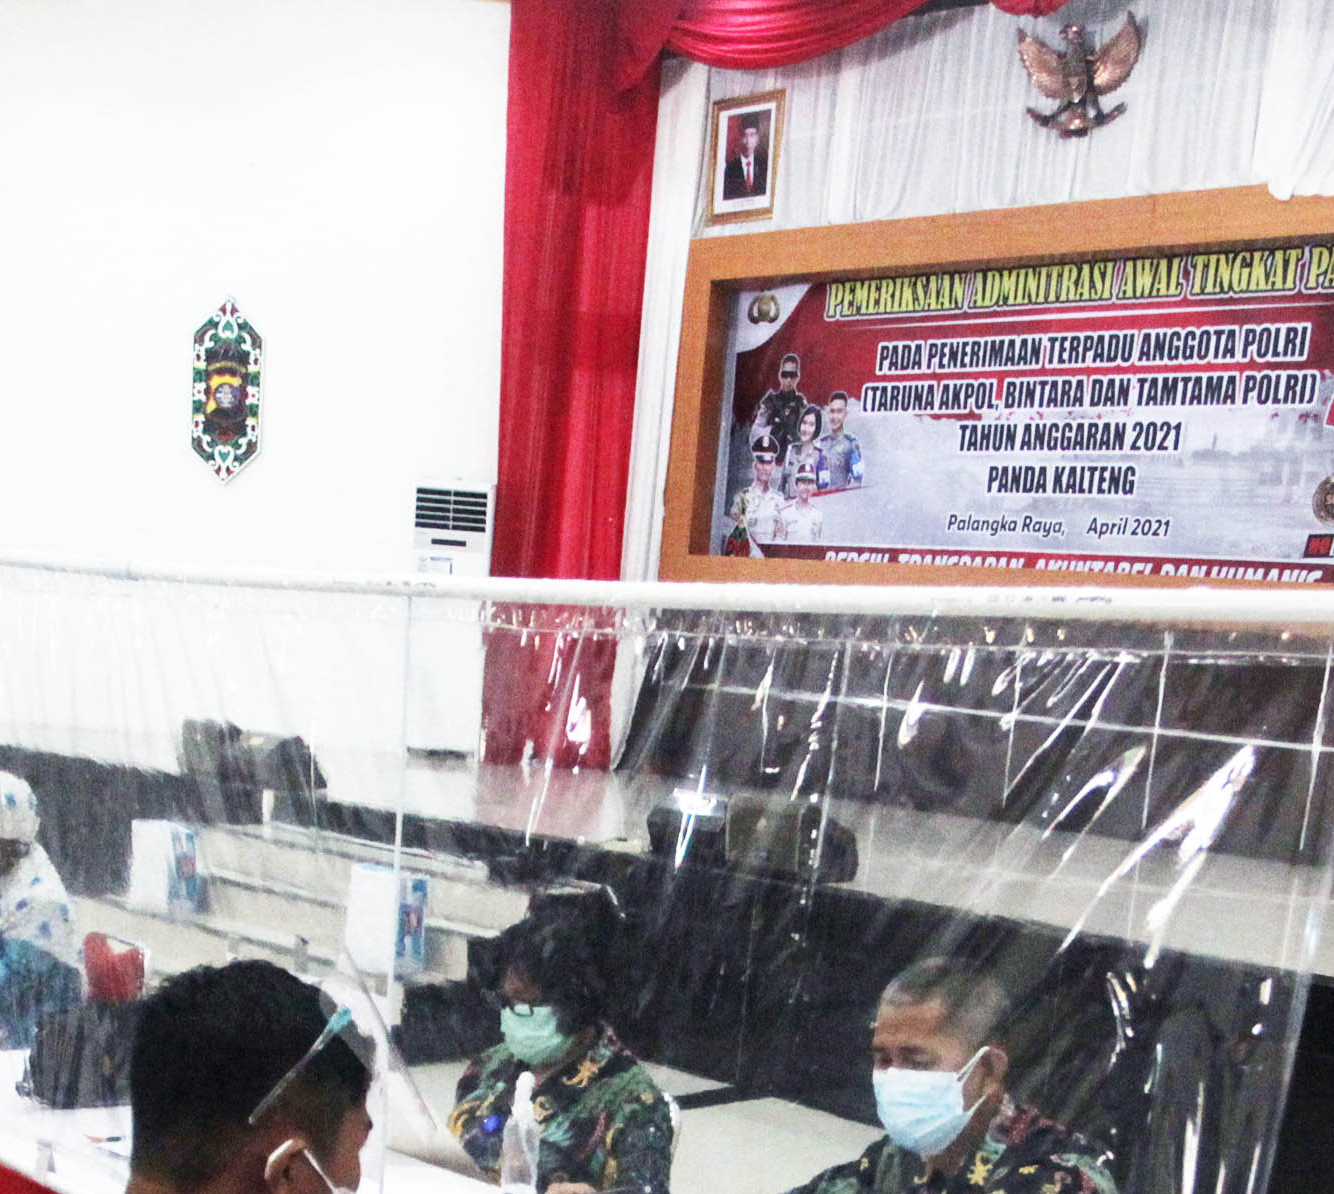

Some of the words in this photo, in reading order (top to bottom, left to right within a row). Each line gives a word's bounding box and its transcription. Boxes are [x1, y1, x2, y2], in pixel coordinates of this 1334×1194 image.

[827, 271, 966, 318] PEMERIKSAAN
[967, 261, 1116, 309] ADMINITRASI
[1117, 257, 1183, 300] AWAL
[1189, 248, 1302, 295] TINGKAT
[877, 342, 923, 373] PADA
[927, 336, 1042, 371] PENERIMAAN
[1047, 331, 1135, 366] TERPADU
[1138, 327, 1236, 363] ANGGOTA
[1242, 325, 1308, 360] POLRI
[863, 384, 936, 412] (TARUNA
[938, 380, 999, 411] AKPOL,
[1004, 376, 1083, 409] BINTARA
[1089, 375, 1130, 408] DAN
[1137, 374, 1237, 407] TAMTAMA
[1242, 373, 1316, 405] POLRI)
[959, 424, 1017, 451] TAHUN
[1020, 421, 1126, 451] ANGGARAN
[1130, 421, 1182, 451] 2021
[987, 465, 1047, 493] PANDA
[1052, 465, 1136, 495] KALTENG
[947, 514, 1016, 537] Palangka
[1021, 516, 1066, 538] Raya,
[1087, 517, 1127, 539] April
[1131, 518, 1170, 537] 2021
